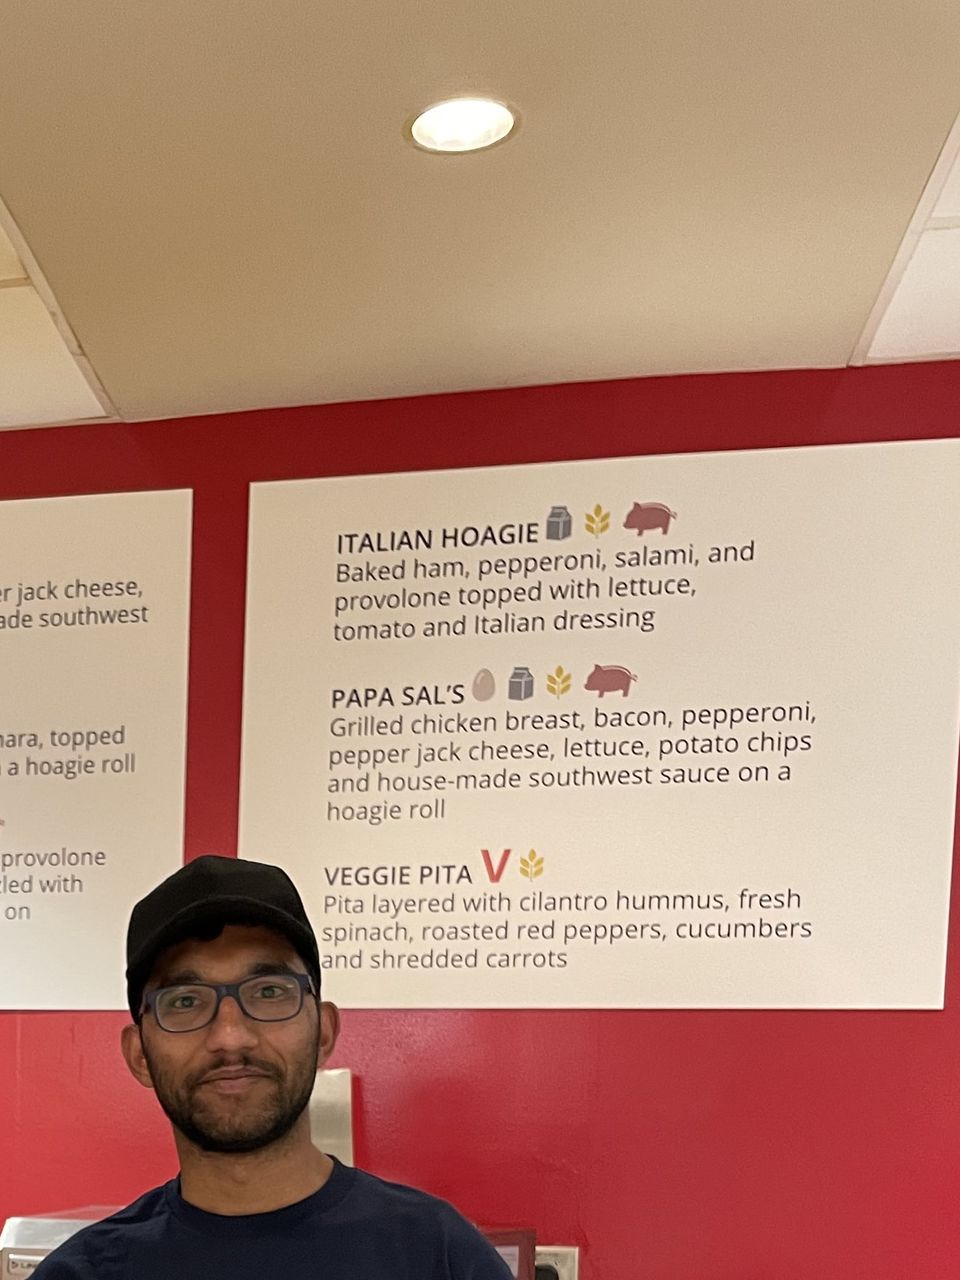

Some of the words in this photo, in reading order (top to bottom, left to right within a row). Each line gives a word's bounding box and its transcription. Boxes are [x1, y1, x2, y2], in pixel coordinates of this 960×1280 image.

[338, 528, 433, 555] ITALIAN
[442, 522, 539, 550] HOAGIE
[337, 558, 406, 584] Baked
[413, 557, 470, 580] ham,
[478, 548, 607, 583] pepperoni,
[614, 543, 700, 568] salami,
[708, 539, 754, 563] and
[15, 581, 58, 607] jack
[64, 578, 142, 599] cheese,
[335, 587, 451, 619] provolone
[458, 579, 542, 611] topped
[549, 576, 601, 600] with
[608, 571, 696, 598] lettuce,
[39, 605, 149, 627] southwest
[334, 620, 416, 641] tomato
[423, 614, 467, 637] and
[475, 612, 545, 635] Italian
[552, 602, 656, 632] dressing
[332, 687, 395, 709] PAPA
[401, 684, 465, 706] SAL'S
[330, 714, 403, 737] Grilled
[411, 712, 497, 734] chicken
[506, 710, 586, 732] breast,
[594, 707, 673, 728] bacon,
[682, 700, 816, 731] pepperoni,
[50, 725, 125, 752] topped
[329, 748, 411, 771] pepper
[414, 741, 462, 768] jack
[469, 740, 555, 762] cheese,
[564, 737, 650, 758] lettuce,
[659, 734, 739, 761] potato
[747, 730, 812, 758] chips
[7, 762, 19, 776] a
[26, 754, 95, 780] hoagie
[102, 753, 135, 773] roll
[328, 771, 370, 793] and
[378, 768, 521, 792] house-made
[528, 765, 653, 788] southwest
[660, 767, 730, 784] sauce
[738, 766, 768, 782] on
[778, 765, 791, 781] a
[328, 800, 401, 826] hoagie
[410, 798, 445, 819] roll
[2, 847, 106, 872] provolone
[39, 874, 83, 893] with
[324, 866, 411, 886] VEGGIE
[420, 864, 473, 885] PITA
[5, 905, 32, 920] on
[324, 895, 364, 914] Pita
[373, 892, 455, 919] layered
[463, 892, 511, 912] with
[520, 891, 607, 911] cilantro
[617, 890, 729, 912] hummus,
[738, 888, 800, 909] fresh
[322, 921, 413, 947] spinach,
[422, 920, 508, 941] roasted
[518, 919, 555, 940] red
[564, 923, 667, 945] peppers,
[676, 917, 812, 939] cucumbers
[321, 949, 362, 969] and
[370, 948, 478, 969] shredded
[487, 950, 567, 968] carrots
